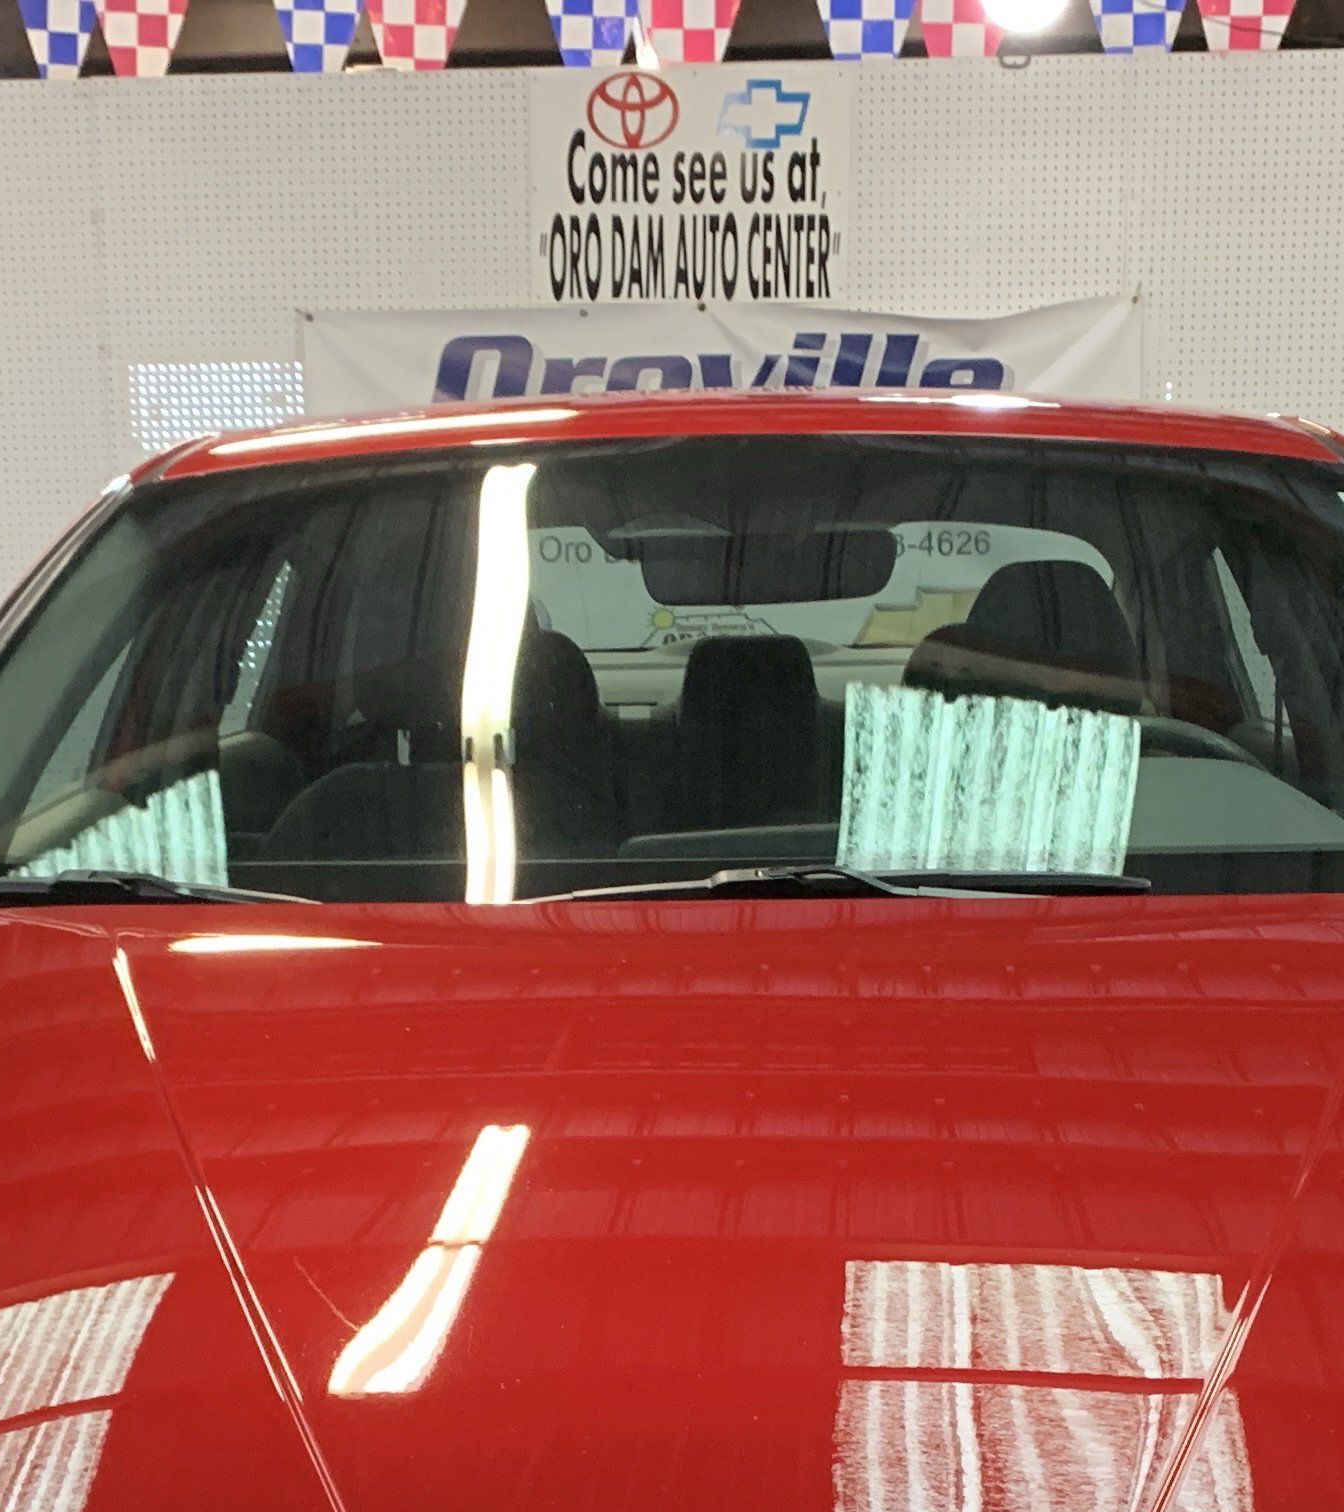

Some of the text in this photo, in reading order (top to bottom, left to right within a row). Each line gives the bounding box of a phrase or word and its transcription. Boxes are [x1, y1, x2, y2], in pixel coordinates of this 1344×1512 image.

[567, 127, 660, 205] Come
[672, 151, 727, 205] see
[740, 151, 775, 205] us
[612, 213, 666, 299] DAM
[674, 211, 739, 302] AUTO
[539, 535, 593, 564] Oro
